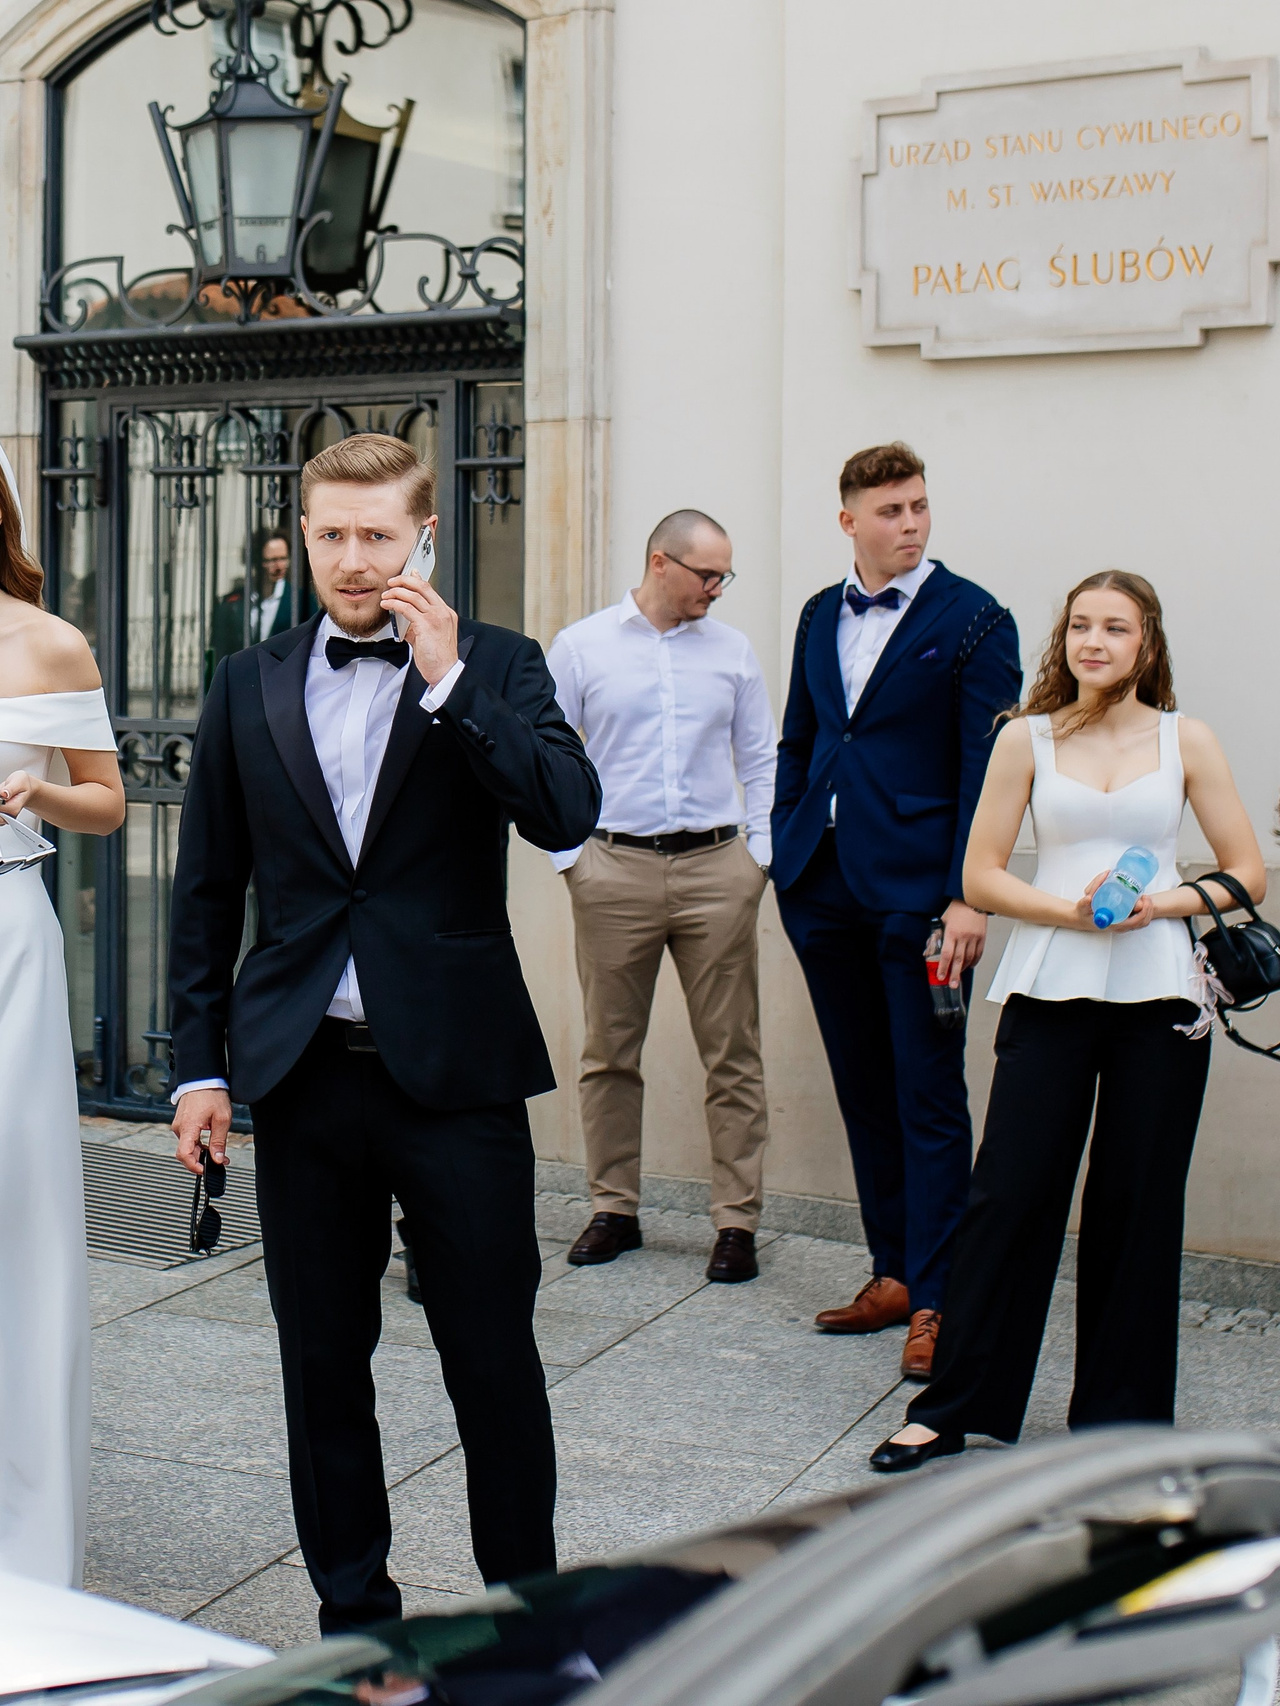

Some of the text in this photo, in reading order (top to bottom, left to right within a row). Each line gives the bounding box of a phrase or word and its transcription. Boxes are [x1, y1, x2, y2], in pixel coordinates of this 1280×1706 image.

[889, 111, 1242, 168] URZĄD STANU CYWILNEGO
[947, 189, 975, 211] M.
[1031, 171, 1175, 202] WARSZAWY
[913, 236, 1214, 296] PAŁAC ŚLUBÓW
